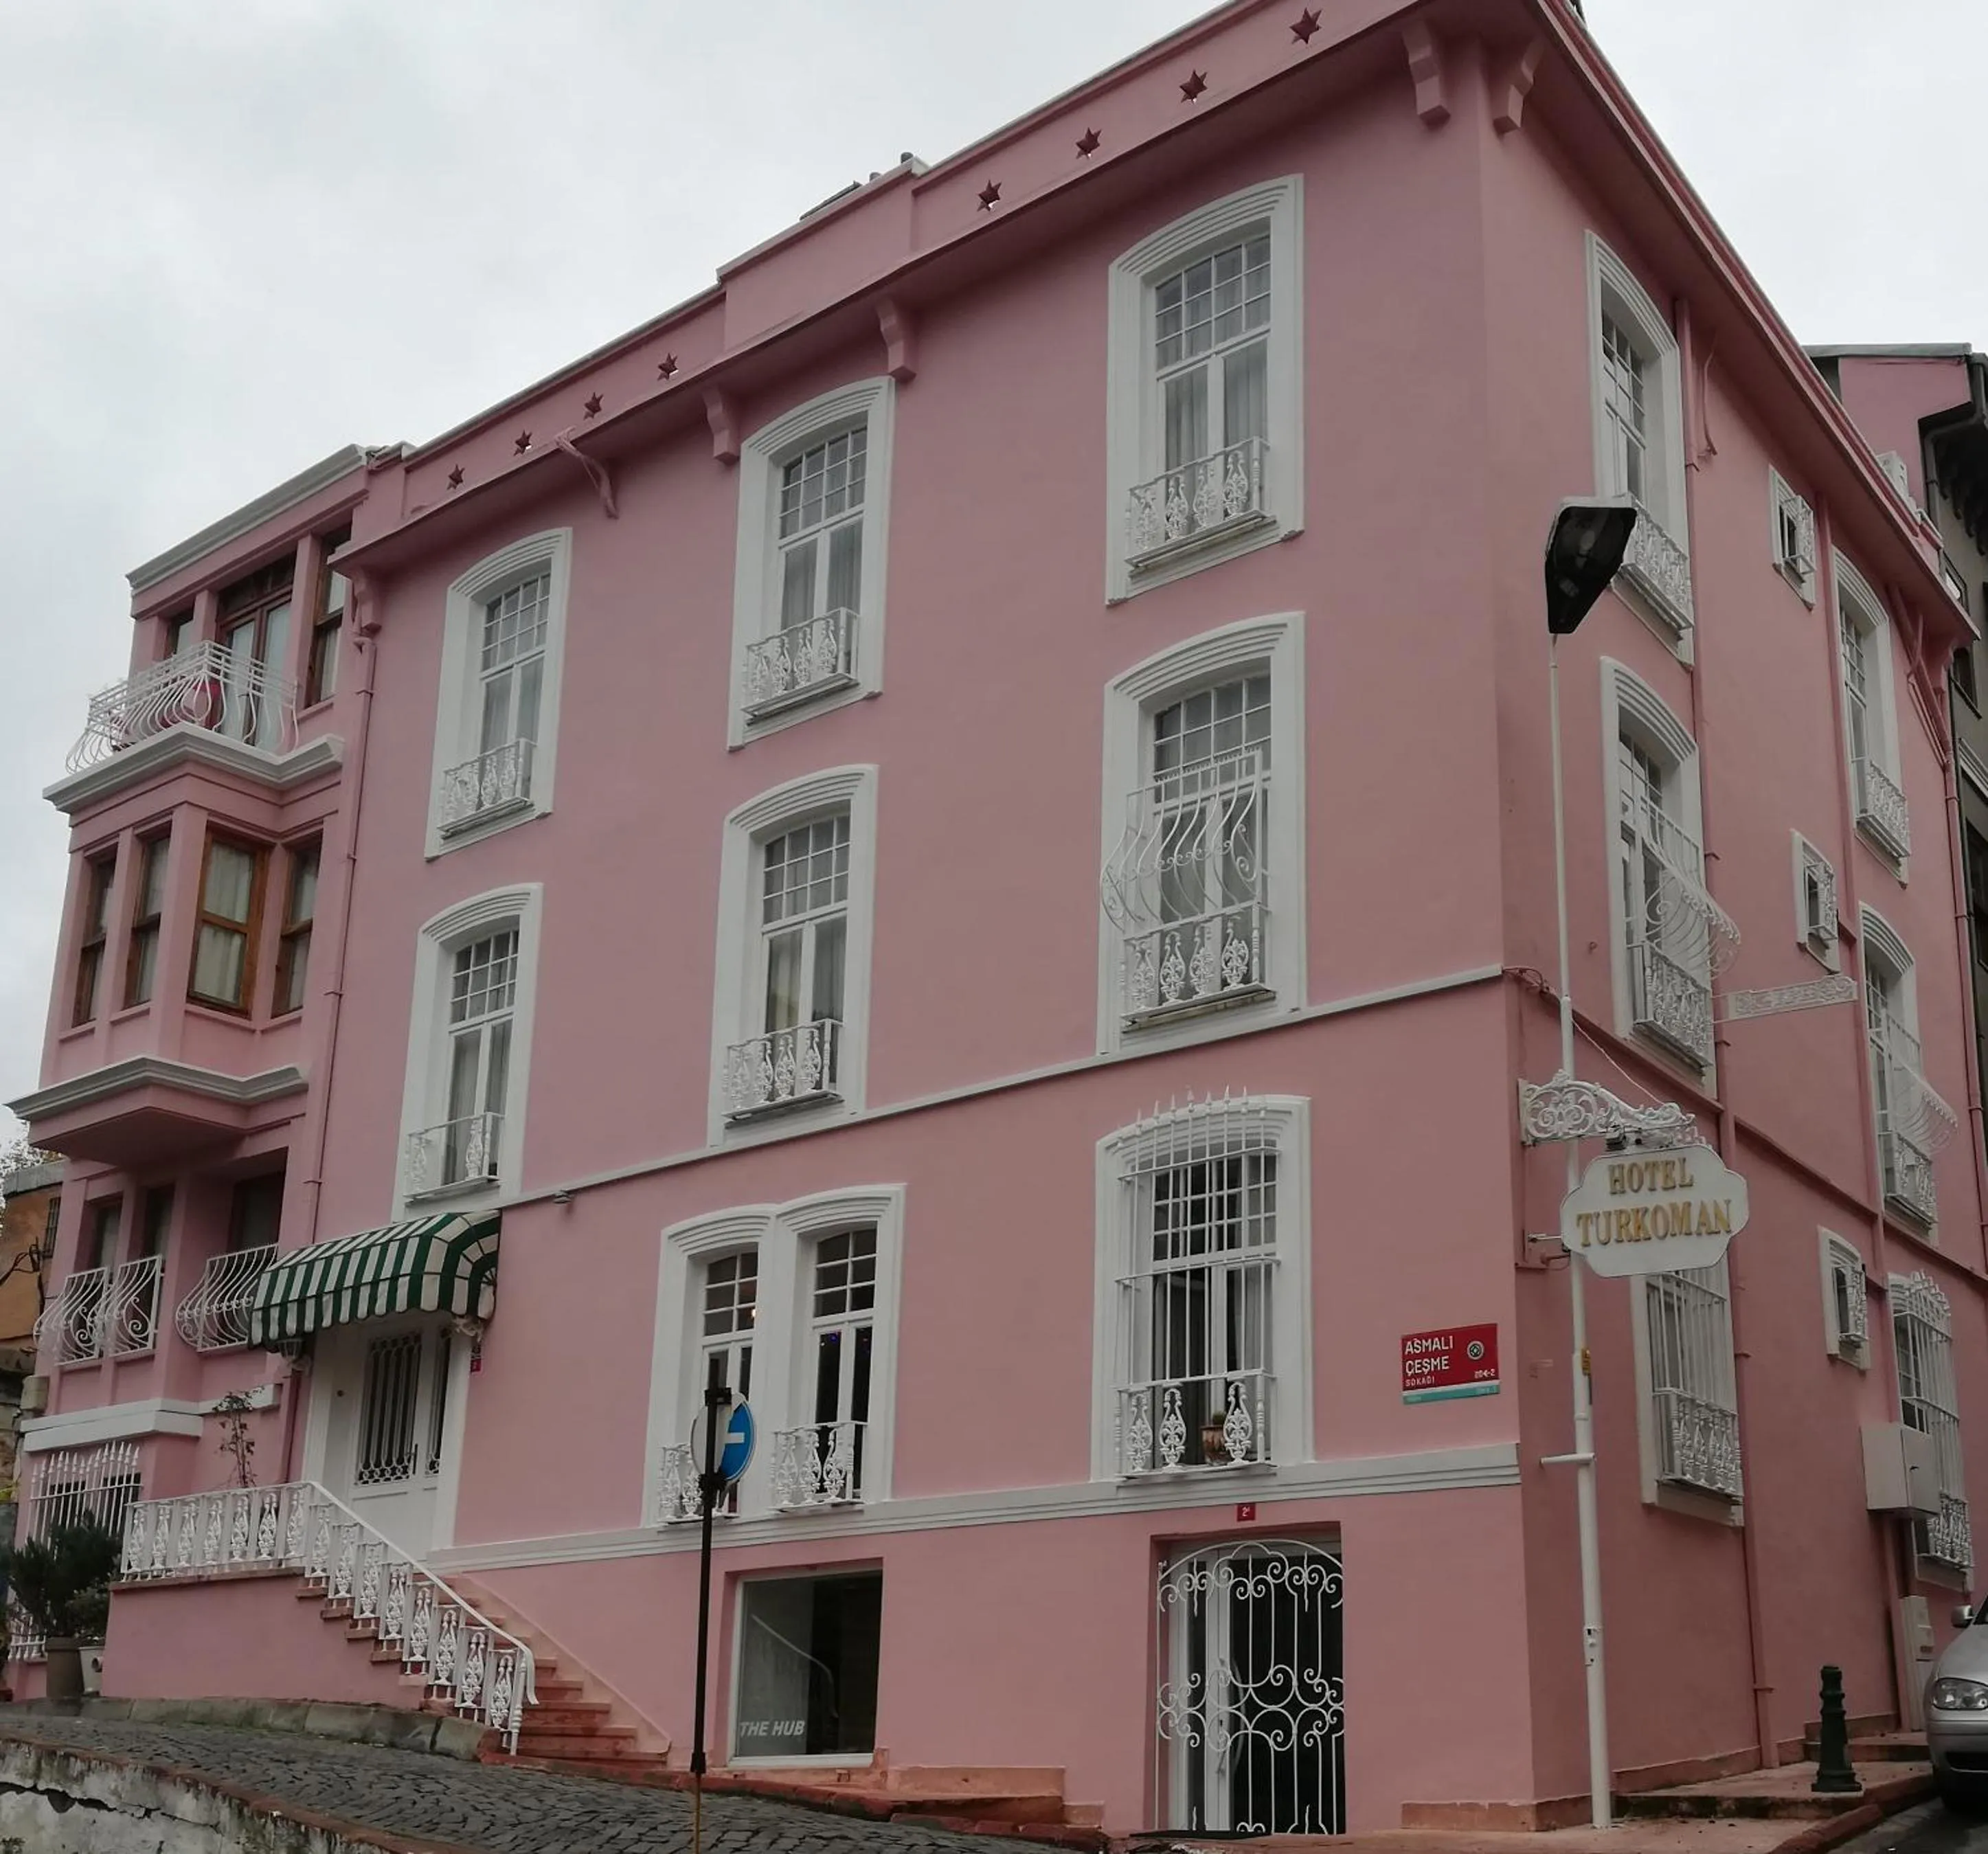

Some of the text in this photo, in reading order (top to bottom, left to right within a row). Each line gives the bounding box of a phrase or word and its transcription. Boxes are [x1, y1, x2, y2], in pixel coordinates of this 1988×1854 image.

[1607, 1157, 1695, 1195] HOTEL
[1576, 1199, 1732, 1247] TURKOMAN
[1405, 1335, 1454, 1355] ASMALI
[1405, 1355, 1450, 1377] ÇEŞME
[740, 1720, 805, 1737] THE HUB
